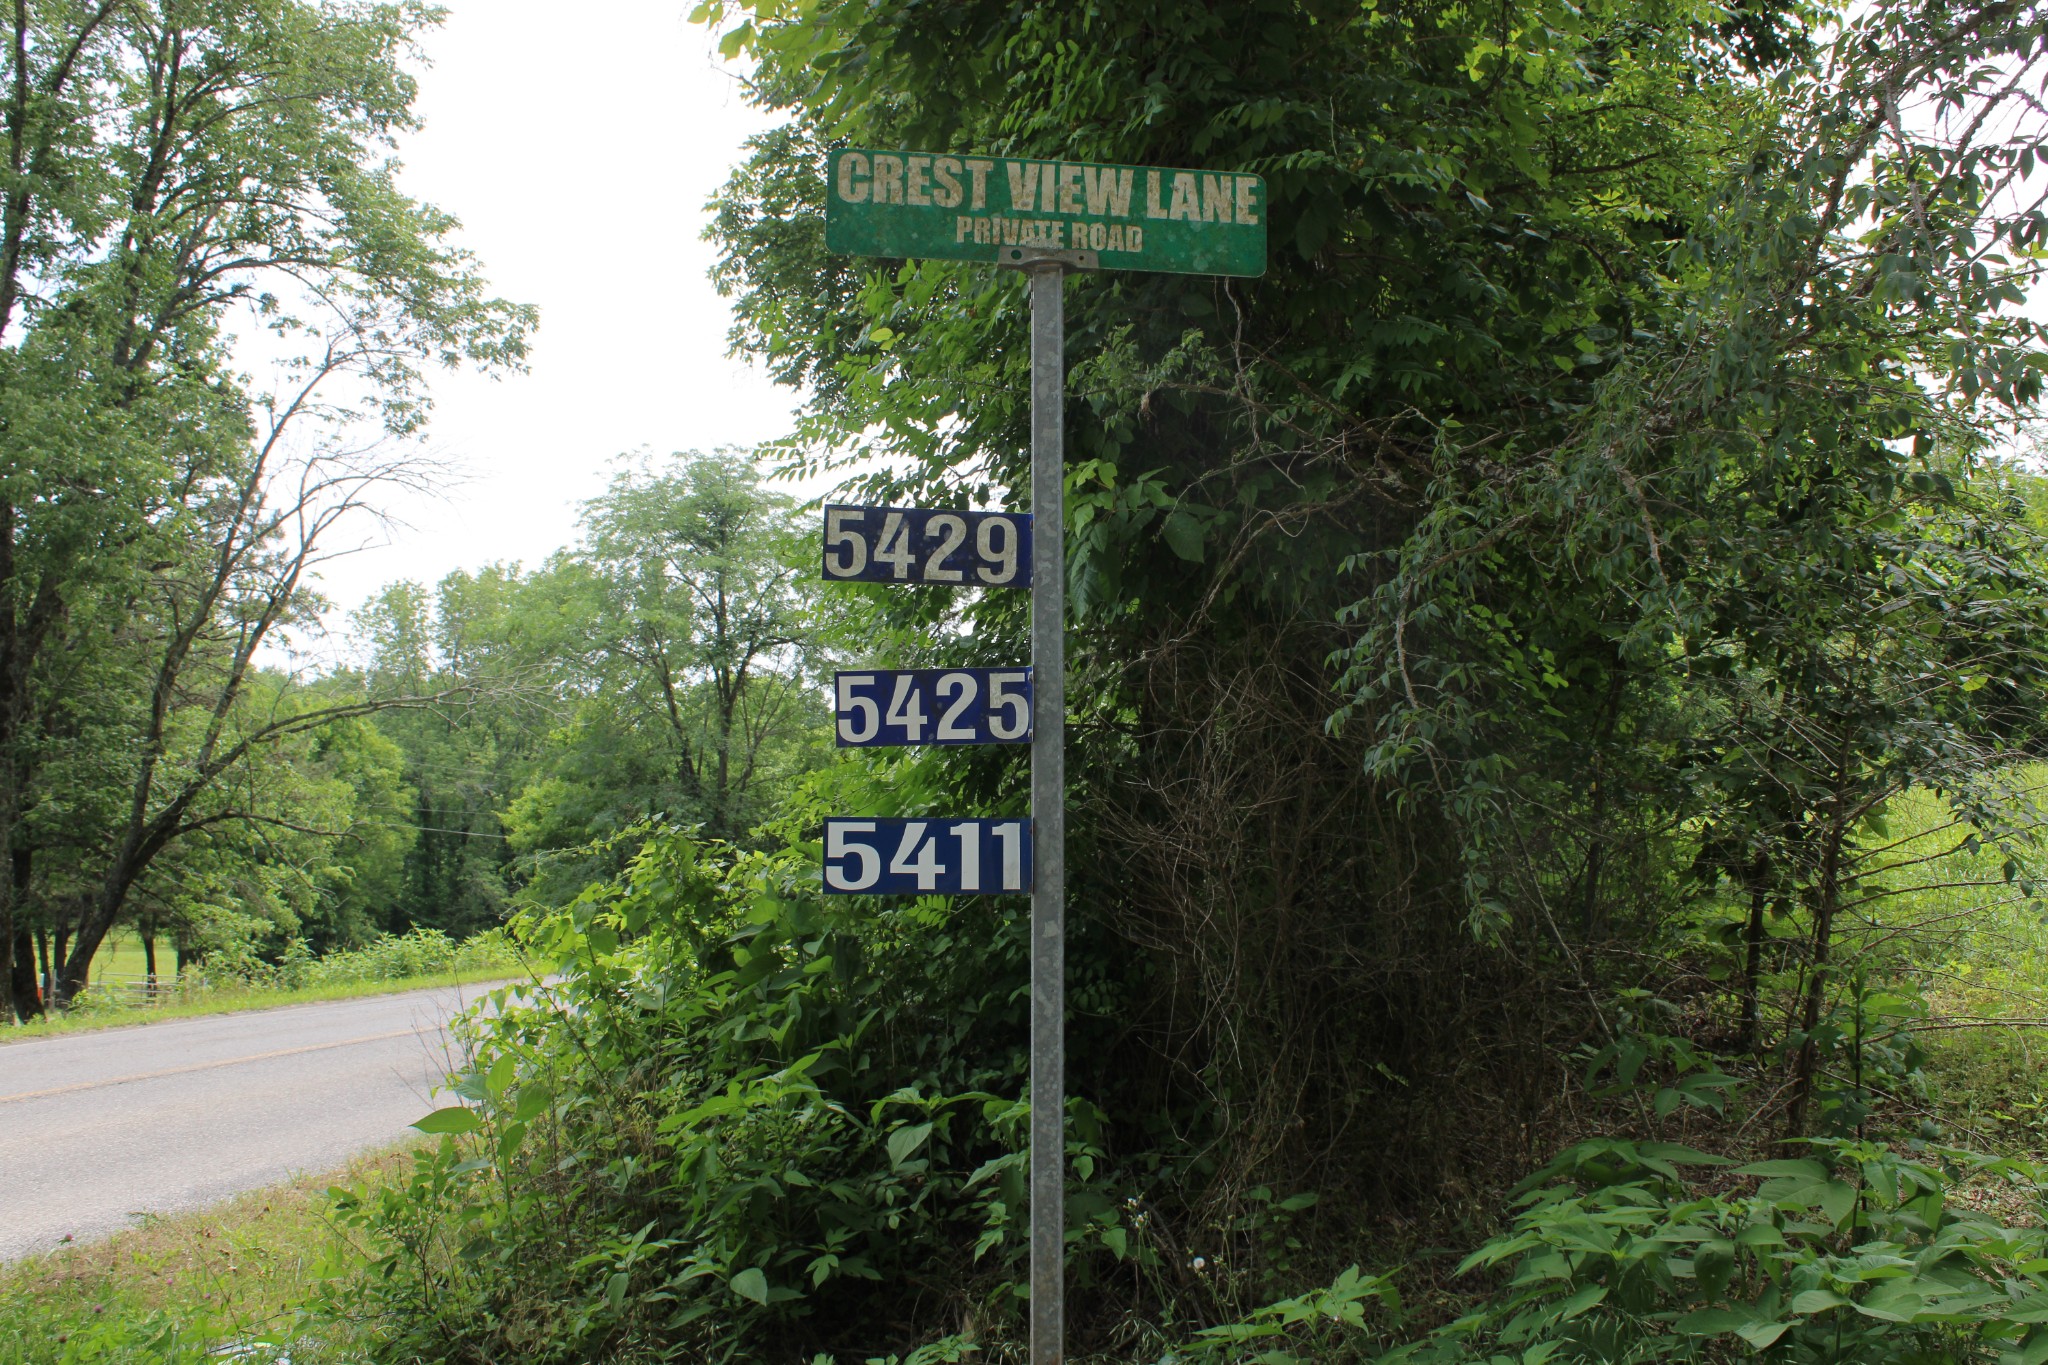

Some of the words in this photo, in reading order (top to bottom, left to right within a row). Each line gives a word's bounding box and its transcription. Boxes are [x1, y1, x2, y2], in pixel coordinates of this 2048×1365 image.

[837, 152, 993, 211] CREST
[1007, 162, 1134, 217] VIEW
[1147, 170, 1258, 225] LANE
[956, 216, 1064, 248] PRIVATE
[1071, 222, 1143, 253] ROAD
[826, 509, 1018, 584] 5429
[838, 672, 1029, 743] 5425
[826, 822, 1021, 890] 5411
